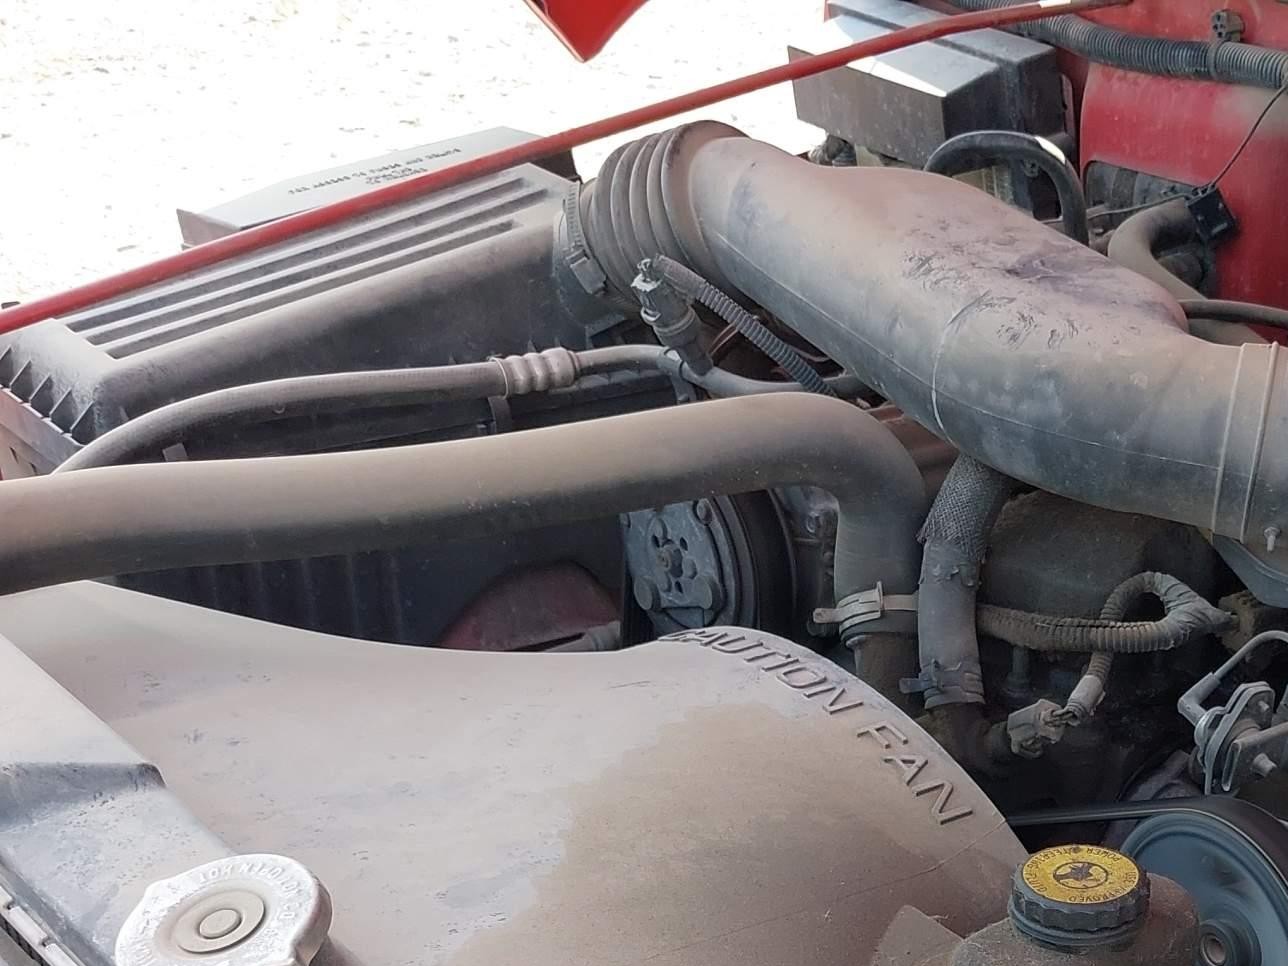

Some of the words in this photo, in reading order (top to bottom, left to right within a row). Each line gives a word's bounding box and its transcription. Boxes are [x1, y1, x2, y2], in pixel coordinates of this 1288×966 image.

[659, 628, 865, 716] CAUTION
[856, 720, 974, 826] FAN
[1086, 847, 1122, 862] POWER
[199, 864, 235, 884] HOT
